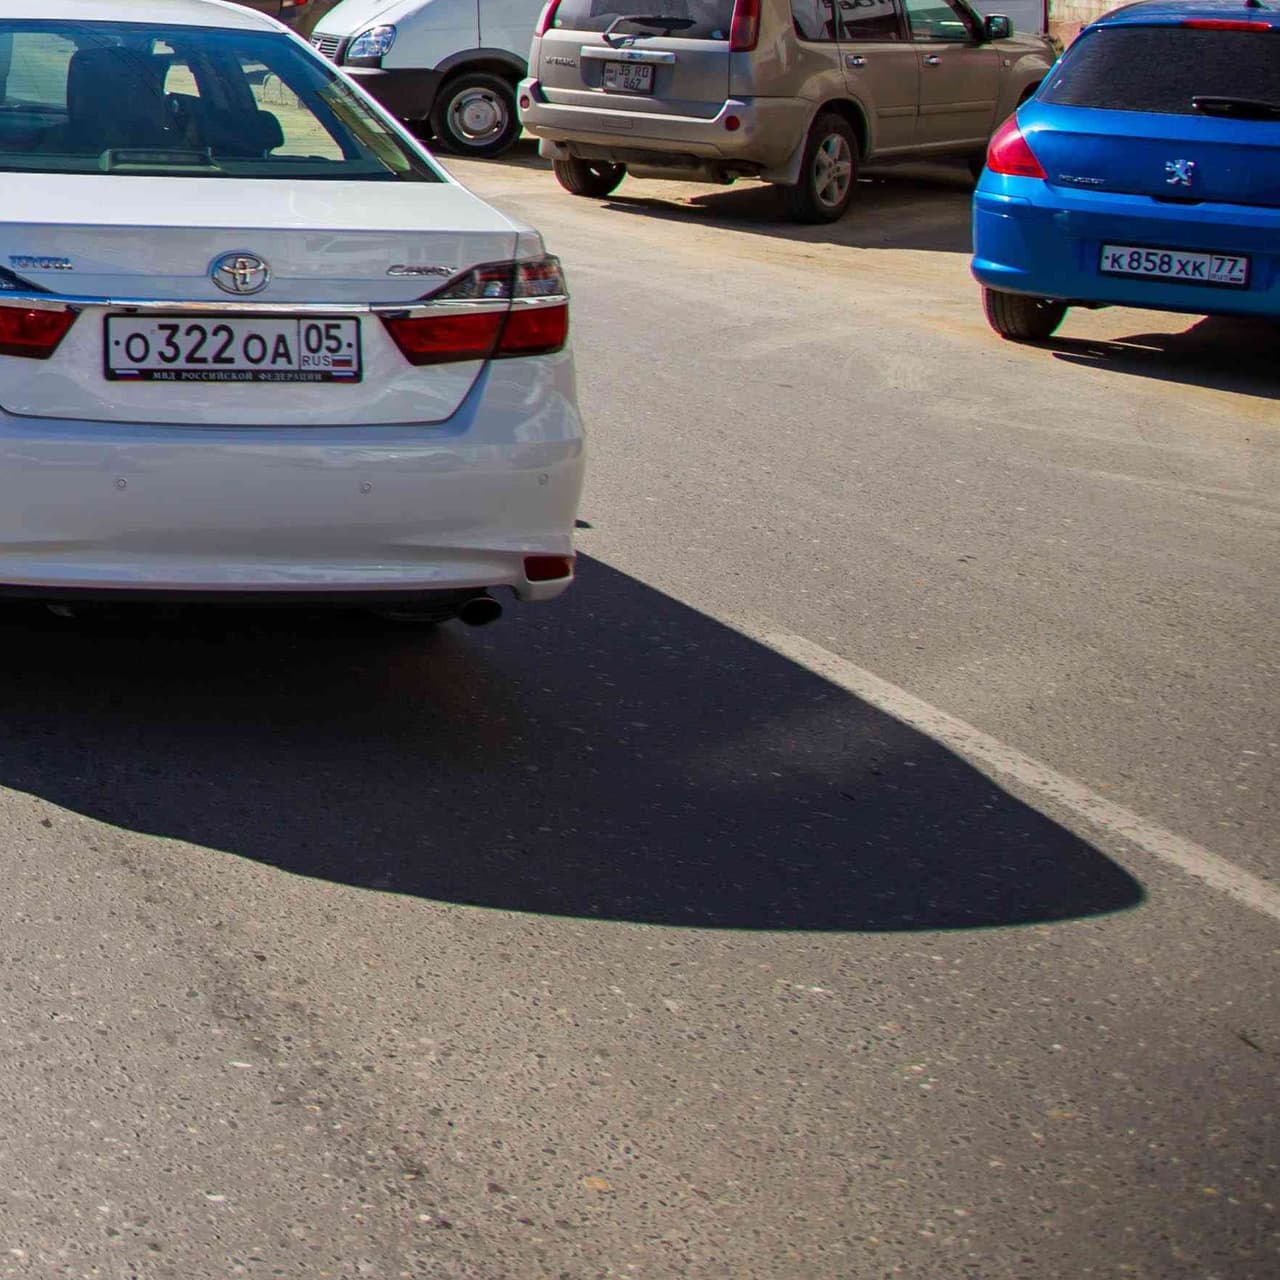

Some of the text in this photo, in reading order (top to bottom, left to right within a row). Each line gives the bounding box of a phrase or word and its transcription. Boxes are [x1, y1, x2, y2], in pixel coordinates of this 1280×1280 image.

[1214, 255, 1239, 274] 77
[303, 323, 342, 354] 05
[302, 354, 332, 367] RUS
[152, 371, 323, 382] МВД РОССИЙСКОЙ ФЕДЕРАЦИИ
